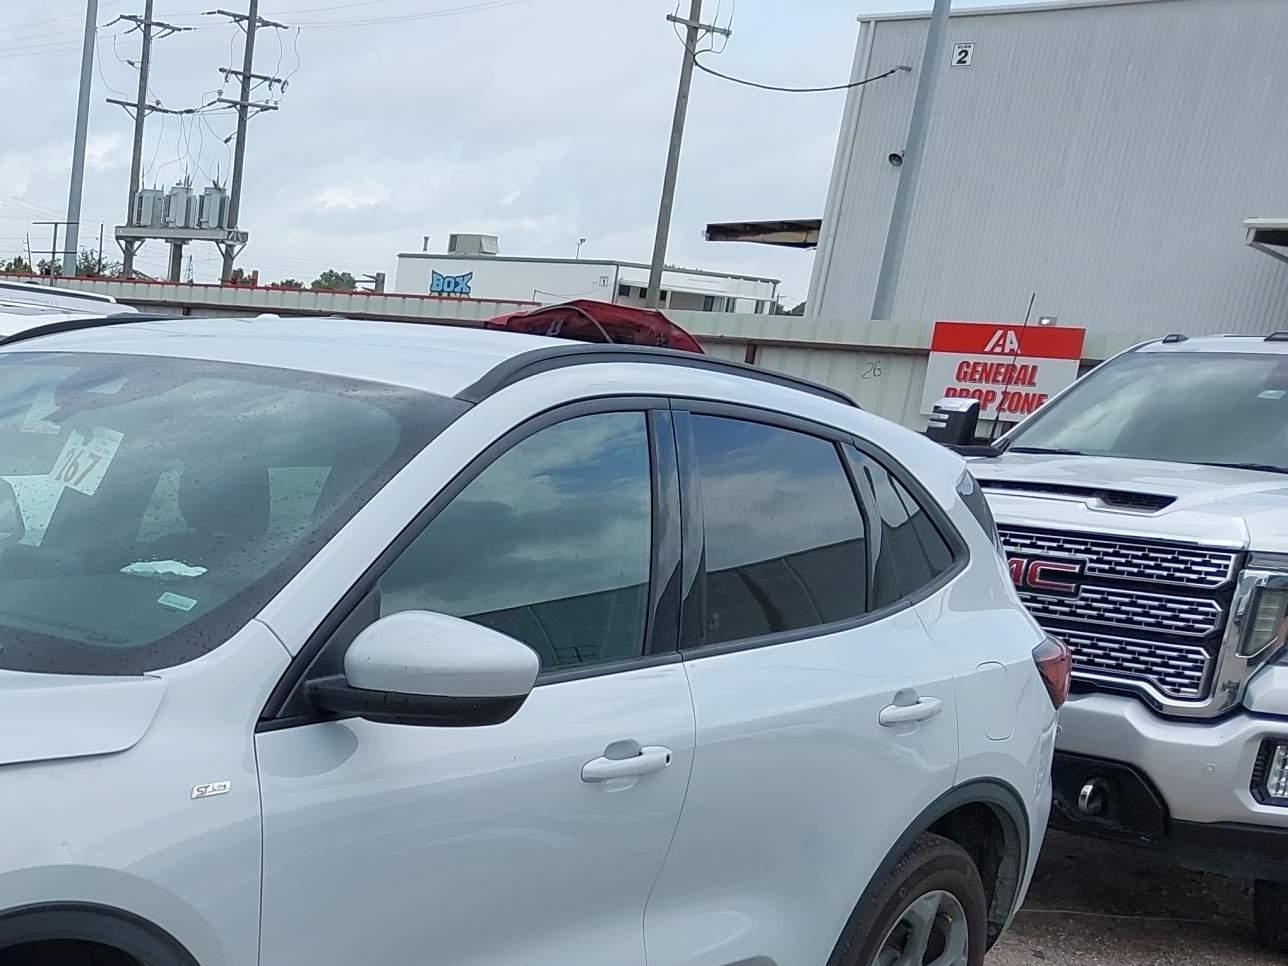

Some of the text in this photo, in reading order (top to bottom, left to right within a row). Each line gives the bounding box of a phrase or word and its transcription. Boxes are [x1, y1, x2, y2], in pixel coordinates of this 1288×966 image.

[956, 49, 968, 64] 2
[430, 269, 473, 294] BOX
[862, 360, 882, 379] 26
[955, 360, 1039, 388] GENERAL
[55, 448, 103, 486] 267
